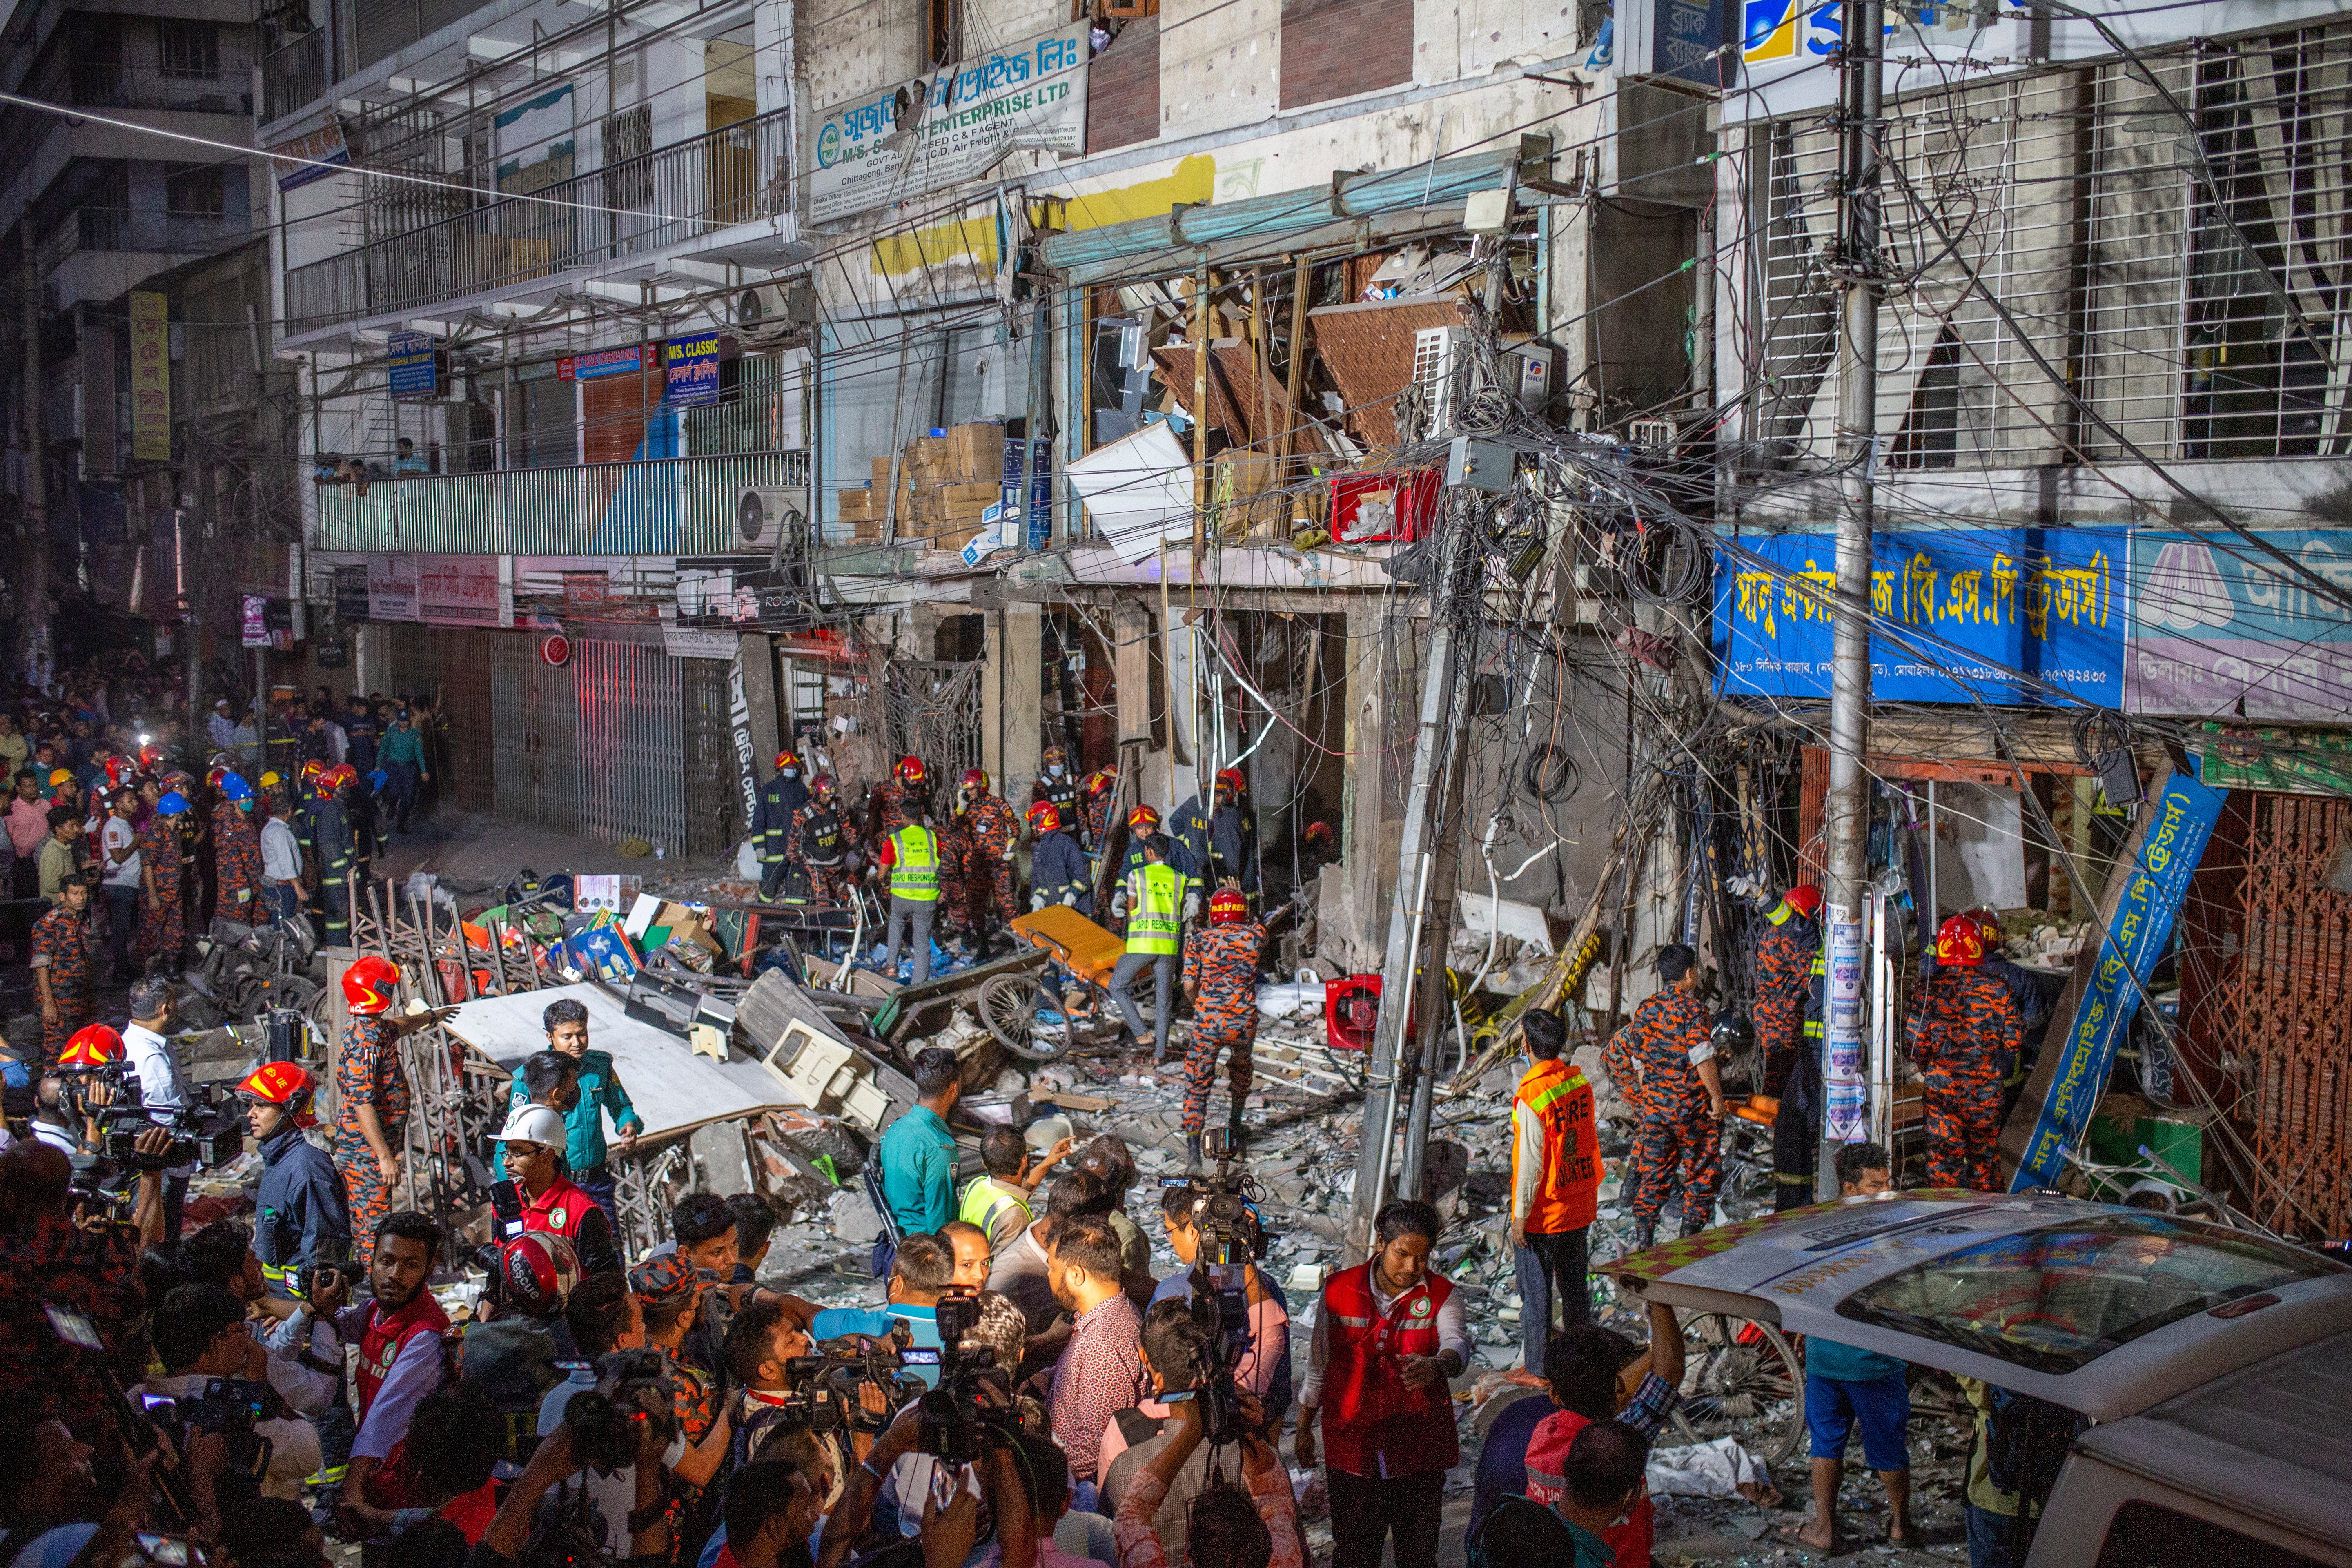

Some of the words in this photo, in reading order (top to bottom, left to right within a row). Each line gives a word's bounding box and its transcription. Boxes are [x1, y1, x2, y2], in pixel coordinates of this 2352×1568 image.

[1036, 38, 1077, 76] লিঃ
[842, 143, 868, 164] M/S.
[930, 92, 1033, 136] ENTERPRISE
[1038, 81, 1070, 105] LTD.
[866, 154, 889, 168] GOVT
[952, 133, 959, 142] C
[972, 129, 977, 137] F
[980, 118, 1017, 134] AGENT.
[842, 167, 883, 186] Chittagong,
[953, 142, 967, 153] Air
[971, 131, 1001, 149] Freight
[1003, 129, 1009, 137] &
[813, 204, 831, 213] Chittagong
[814, 196, 827, 205] Dhaka
[828, 193, 843, 201] Office:
[843, 199, 871, 211] Powrashava
[599, 348, 639, 365] INTERNATIONAL
[668, 345, 684, 360] M/S.
[686, 339, 719, 357] CLASSIC
[668, 361, 692, 384] মেসার্স
[1526, 374, 1544, 383] GREE
[766, 595, 795, 607] ROSA
[1736, 572, 1775, 640] সালু
[319, 647, 341, 655] ROSA
[2212, 648, 2327, 691] মেসার্স
[1554, 1094, 1588, 1133] FIRE
[509, 1251, 540, 1299] Rescue
[863, 1418, 880, 1426] SONY
